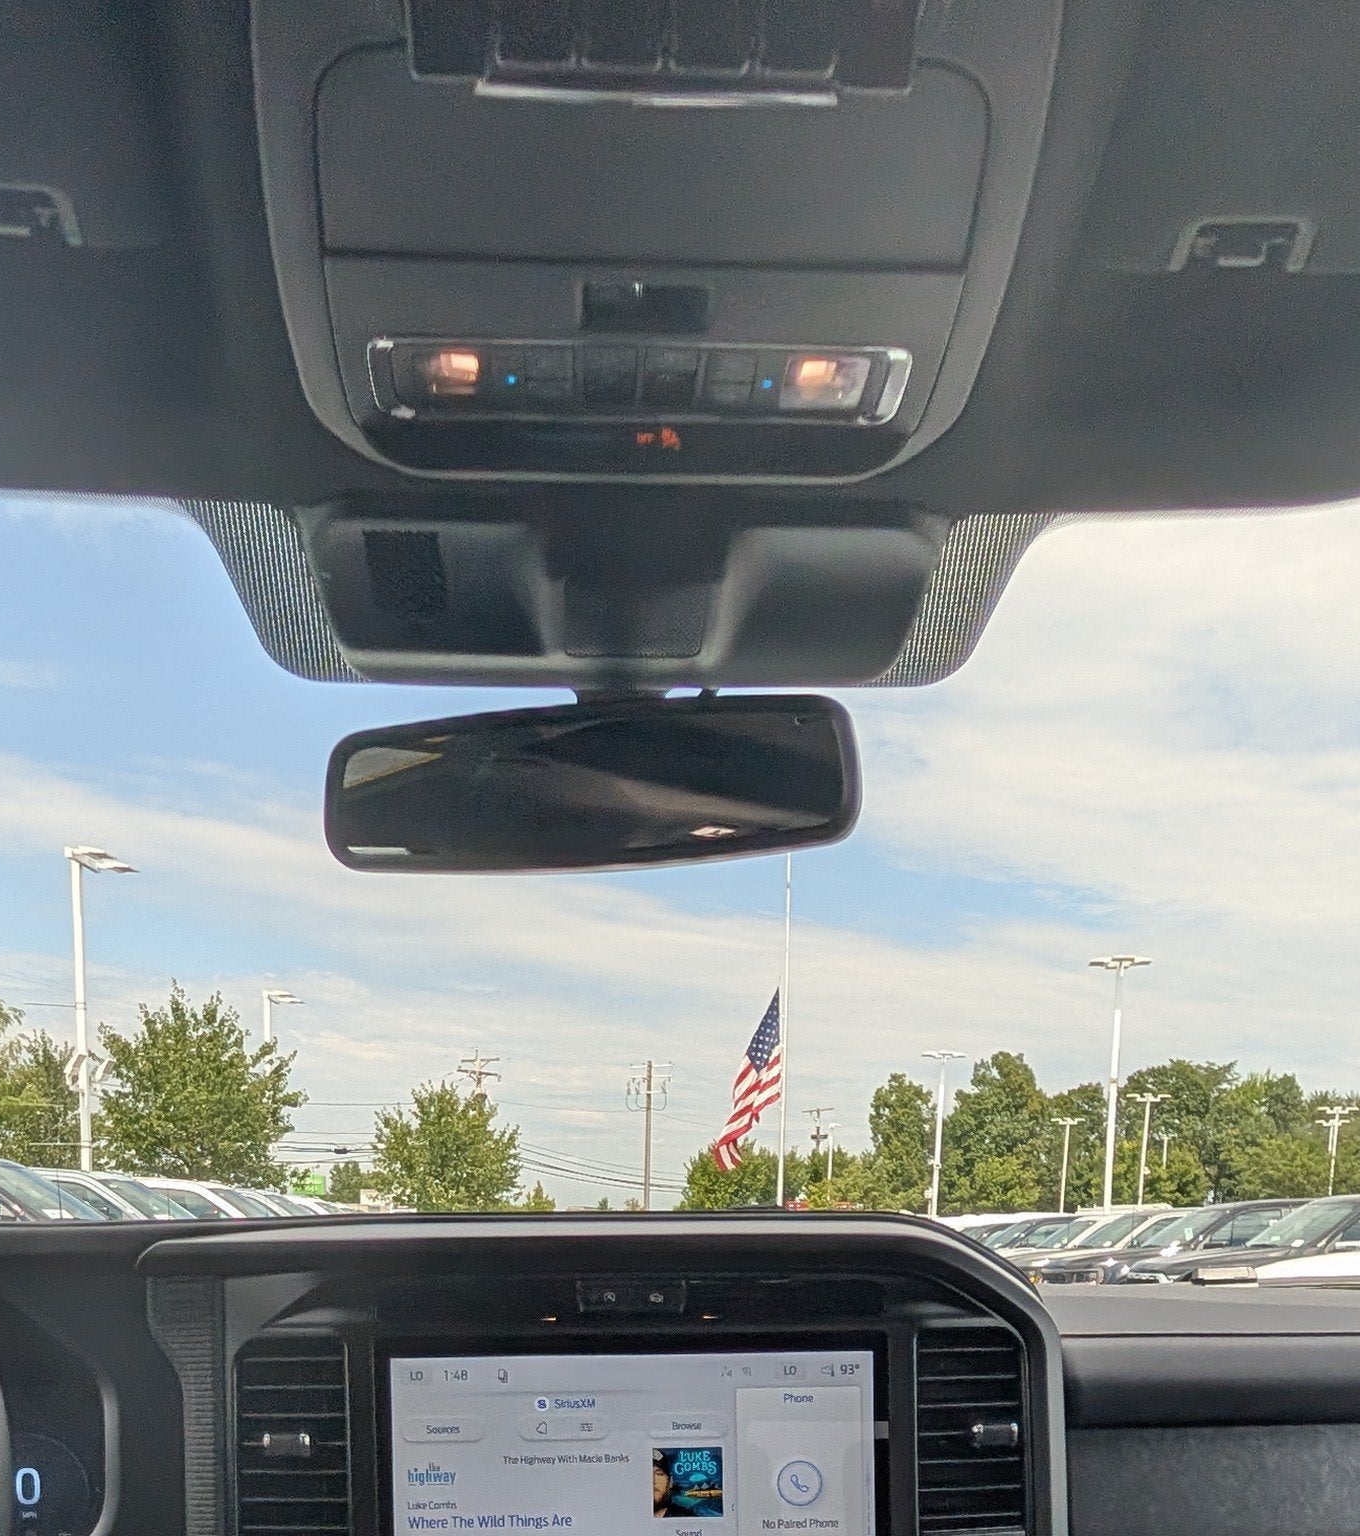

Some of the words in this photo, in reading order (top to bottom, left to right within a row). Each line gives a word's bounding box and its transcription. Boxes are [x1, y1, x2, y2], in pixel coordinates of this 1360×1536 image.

[409, 1371, 424, 1381] LO
[443, 1370, 468, 1381] 1:48
[783, 1366, 797, 1376] LO
[554, 1399, 596, 1409] SiriusXM
[672, 1421, 702, 1431] Browse
[503, 1455, 519, 1465] The
[520, 1455, 555, 1466] Highway
[679, 1450, 711, 1463] LUKE
[674, 1461, 717, 1475] COMBS
[407, 1468, 456, 1486] highway
[16, 1467, 40, 1505] 0
[408, 1516, 448, 1529] Where
[452, 1515, 475, 1528] The
[478, 1515, 505, 1528] Wild
[508, 1514, 549, 1529] Things
[552, 1514, 572, 1527] Are
[762, 1519, 776, 1529] No
[778, 1518, 807, 1529] Paired
[809, 1518, 839, 1528] Phone
